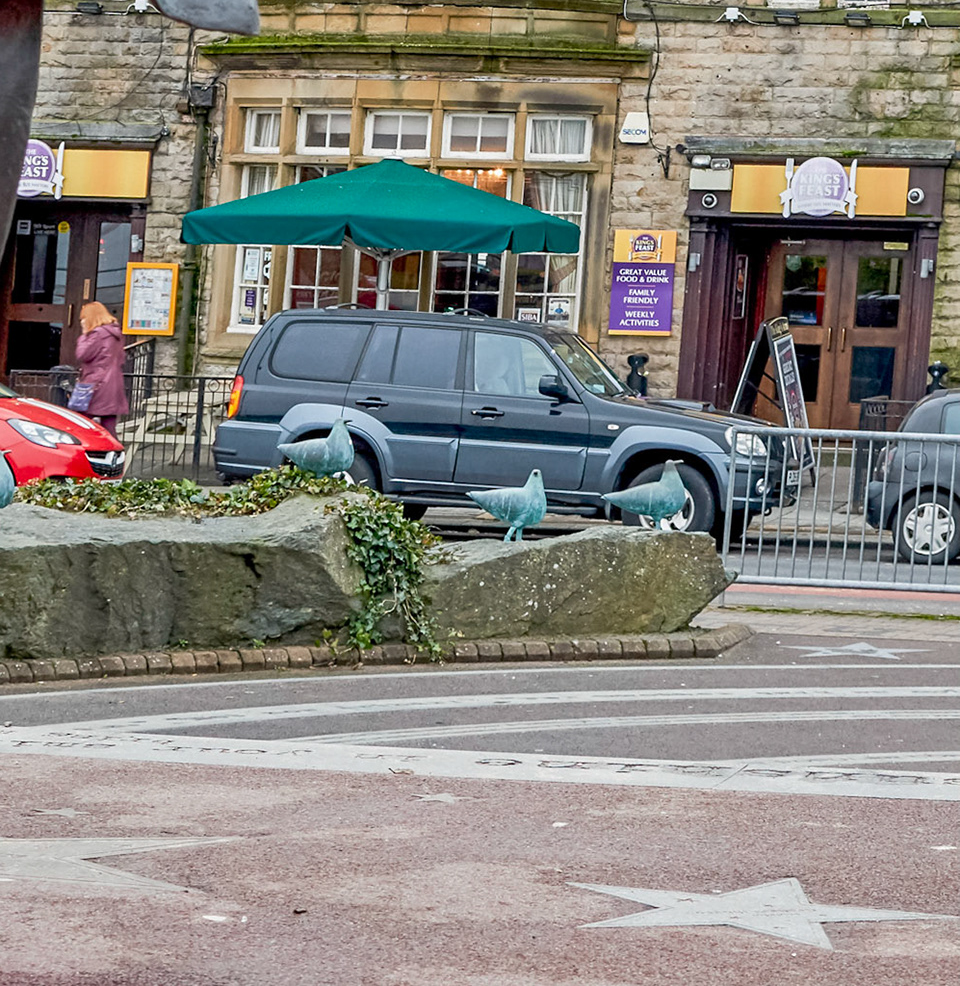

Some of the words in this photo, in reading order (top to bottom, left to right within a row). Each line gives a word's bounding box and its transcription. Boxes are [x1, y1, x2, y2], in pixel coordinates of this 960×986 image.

[622, 128, 647, 136] SECOM
[798, 184, 841, 197] FEAST
[619, 268, 642, 276] GREAT
[616, 275, 638, 283] FOOD
[628, 288, 655, 296] FAMILY
[623, 296, 659, 304] FRIENDLY
[521, 313, 537, 321] SIBA
[625, 310, 655, 318] WEEKLY
[619, 318, 660, 327] ACTIVITIES
